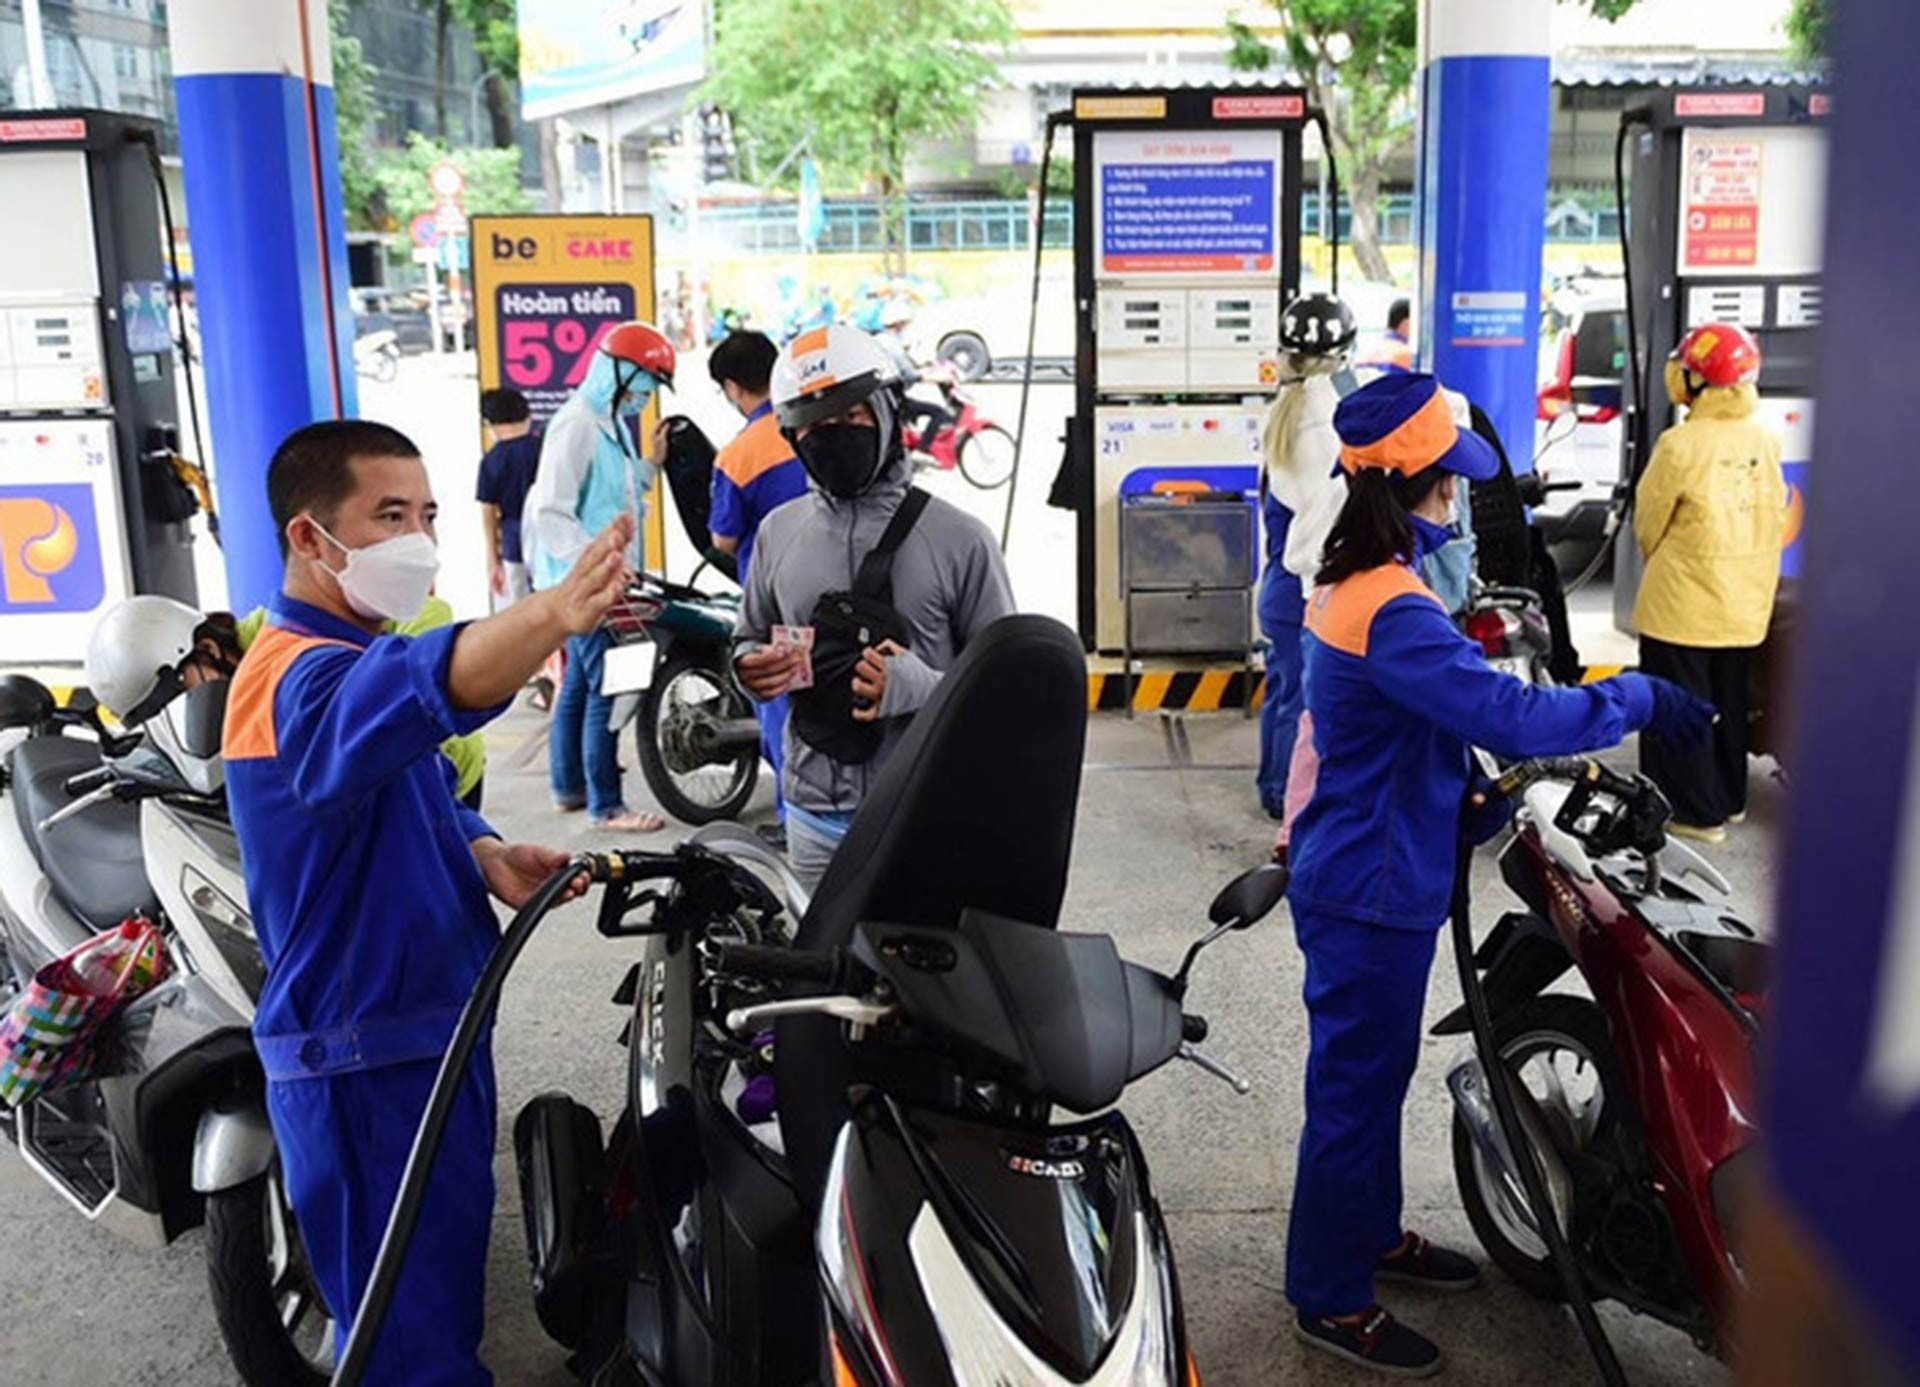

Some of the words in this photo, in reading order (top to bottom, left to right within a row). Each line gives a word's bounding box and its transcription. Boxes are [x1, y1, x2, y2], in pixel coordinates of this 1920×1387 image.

[492, 233, 537, 260] be
[567, 239, 633, 259] CAKE
[502, 289, 569, 315] Hoàn
[571, 286, 621, 314] tiền
[1102, 440, 1121, 453] 21
[652, 961, 665, 1068] CLICK
